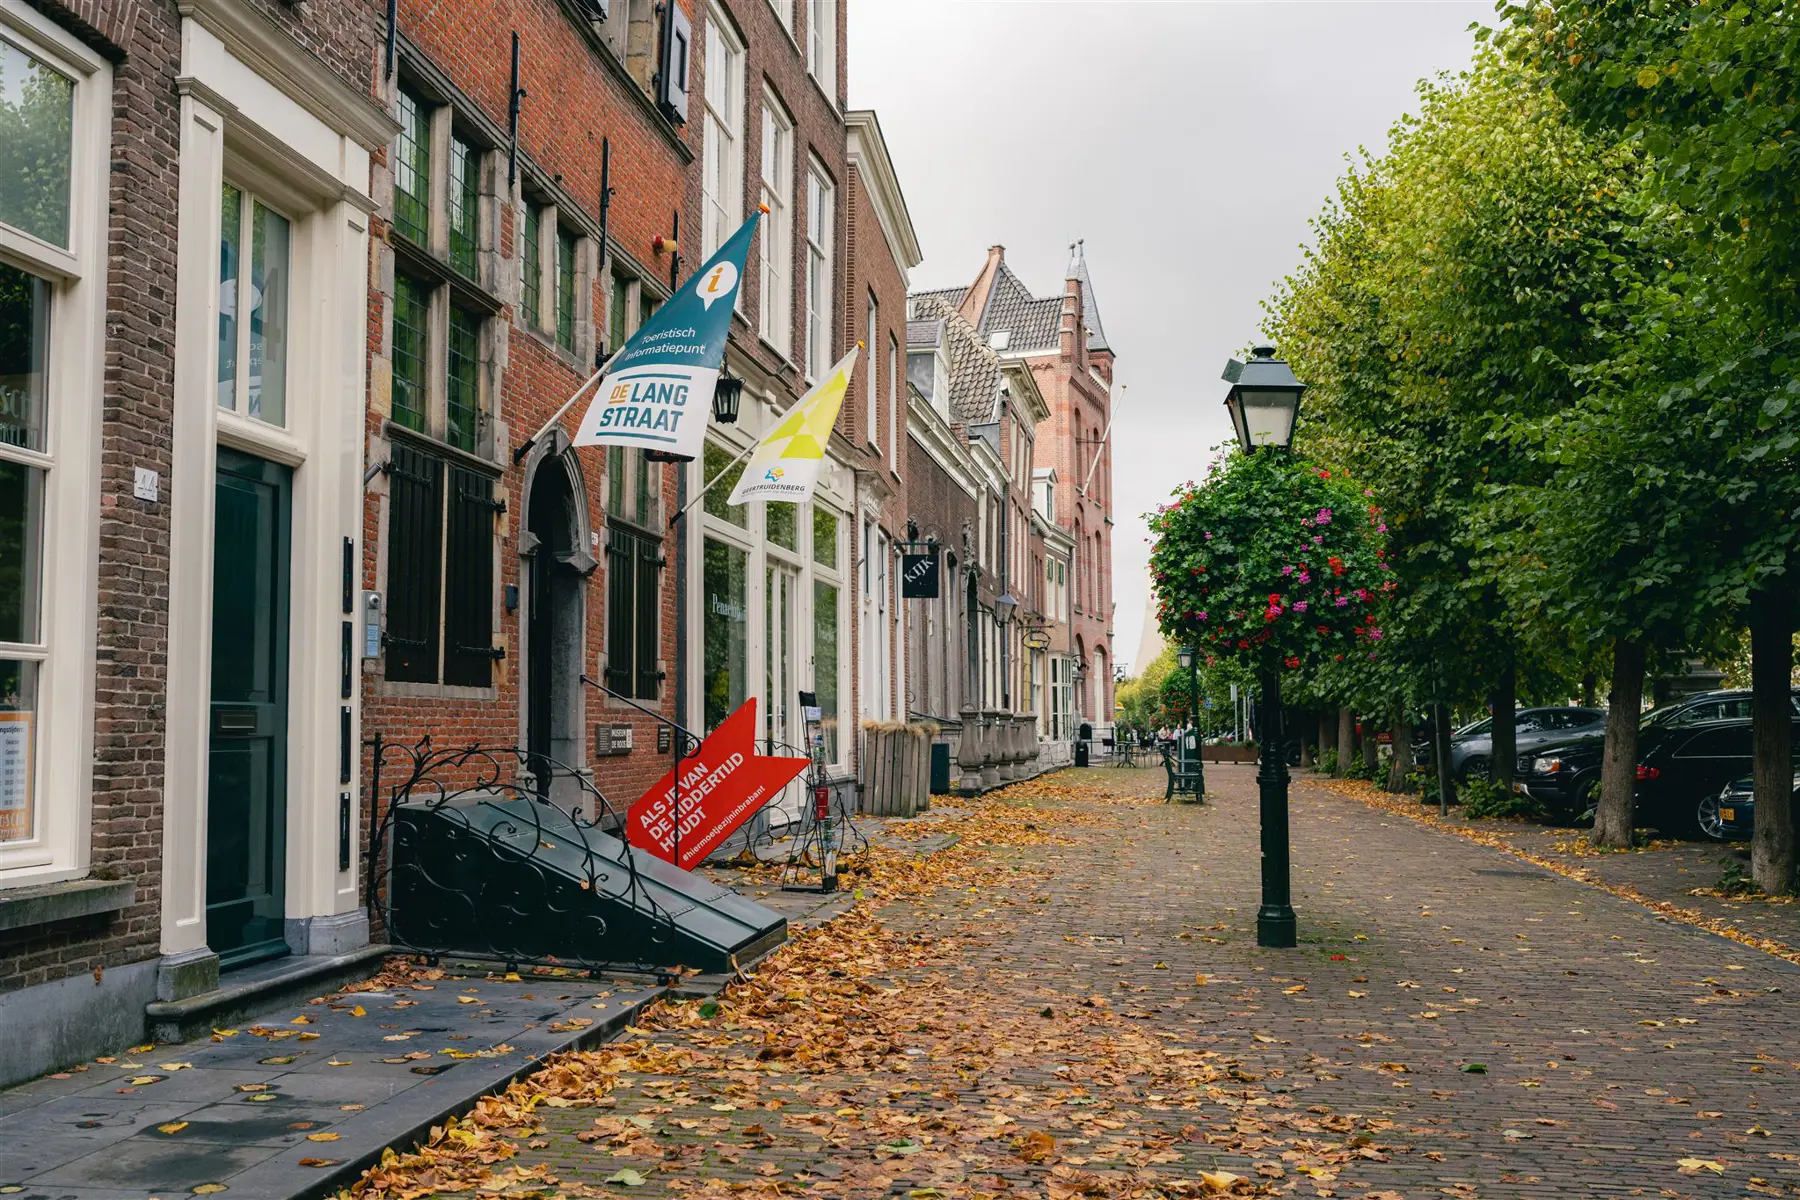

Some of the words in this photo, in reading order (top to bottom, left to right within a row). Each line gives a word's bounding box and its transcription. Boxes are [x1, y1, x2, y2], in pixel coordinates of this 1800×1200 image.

[642, 327, 696, 345] Toeristisch
[609, 383, 631, 400] DE
[630, 382, 689, 407] LANG
[600, 406, 684, 432] STRAAT
[741, 483, 806, 494] GEERTRUIDENBERG
[903, 556, 934, 582] KIJK
[639, 801, 667, 828] ALS
[664, 786, 682, 806] JE
[678, 762, 709, 791] VAN
[649, 818, 672, 840] DE
[669, 752, 744, 822] RIDDERTIJD
[659, 806, 707, 852] HOUDT
[682, 785, 766, 862] #hiermoetjezijninbrabant
